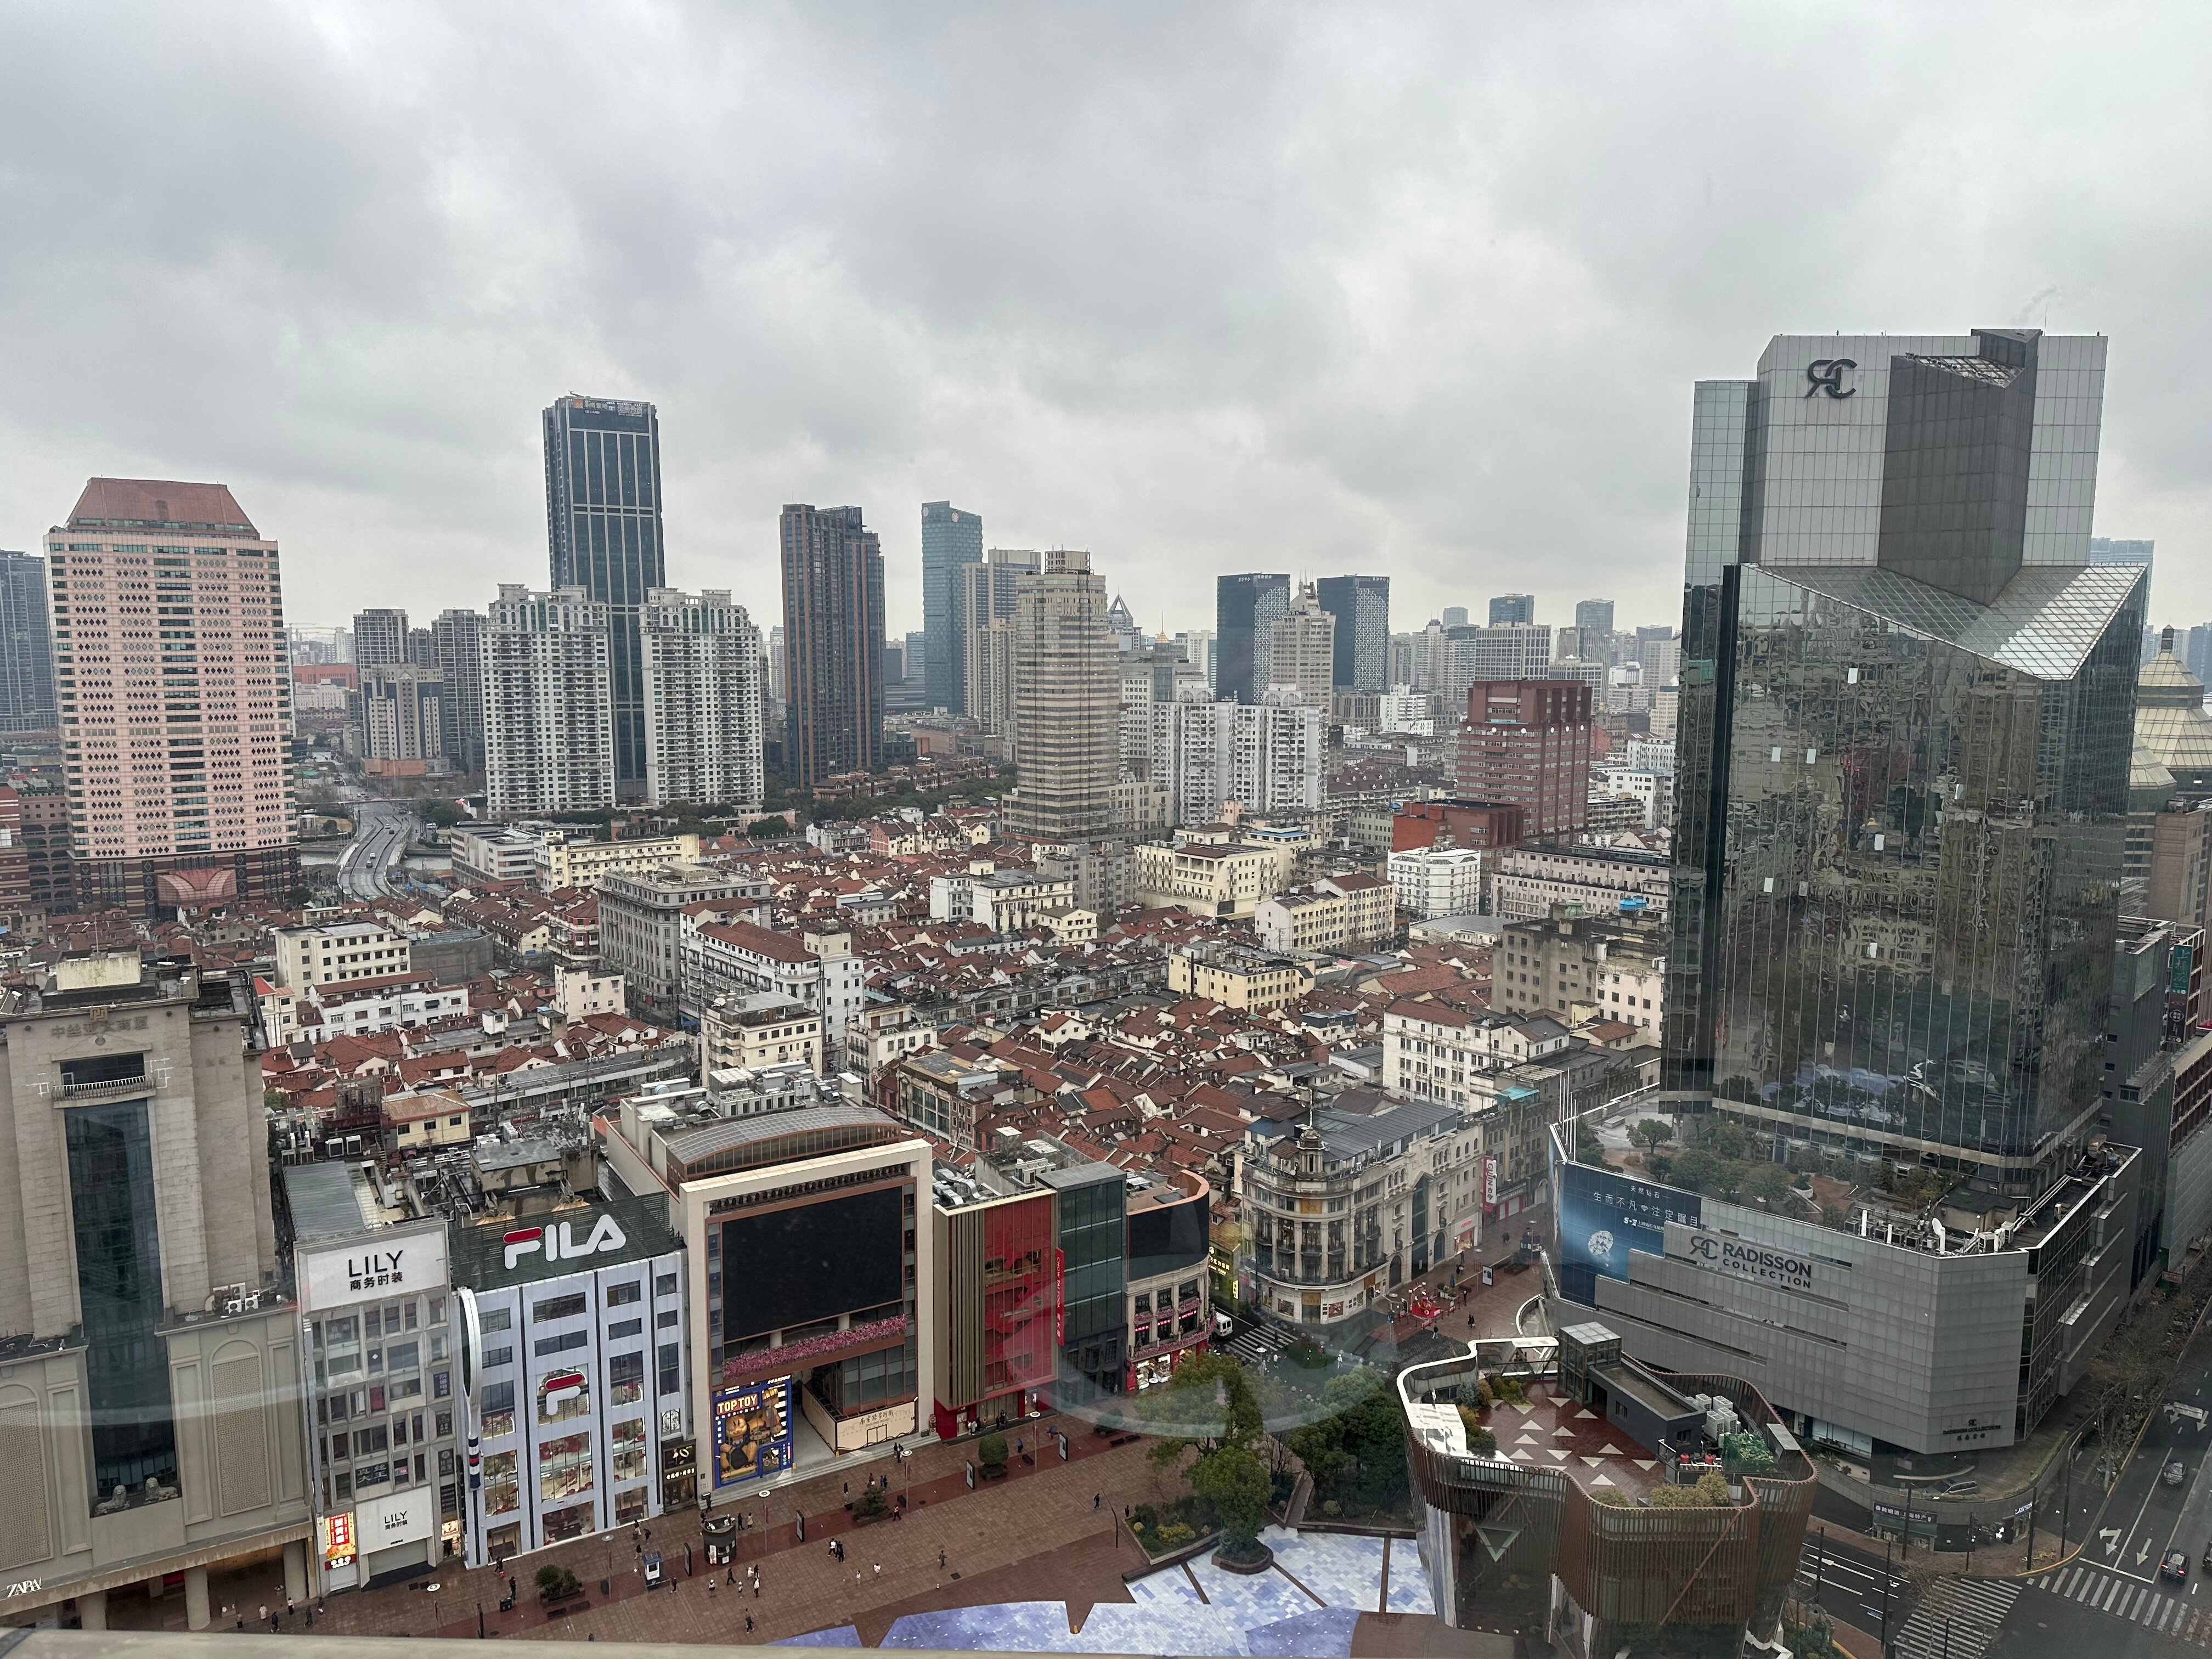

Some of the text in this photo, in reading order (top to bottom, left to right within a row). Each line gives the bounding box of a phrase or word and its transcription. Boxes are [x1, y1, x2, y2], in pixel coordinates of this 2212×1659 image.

[1630, 1185, 1660, 1199] 天然钻石
[1594, 1192, 1698, 1227] 生而不凡 注定瞩目
[503, 1214, 627, 1269] FILA
[348, 1250, 403, 1277] LILY
[1723, 1242, 1812, 1278] RADISSON
[350, 1271, 403, 1291] 商务时装
[1723, 1258, 1810, 1289] COLLECTION
[718, 1400, 737, 1413] TOP
[738, 1395, 757, 1408] TOY
[385, 1510, 407, 1523] LILY
[7, 1577, 42, 1598] ZARA
